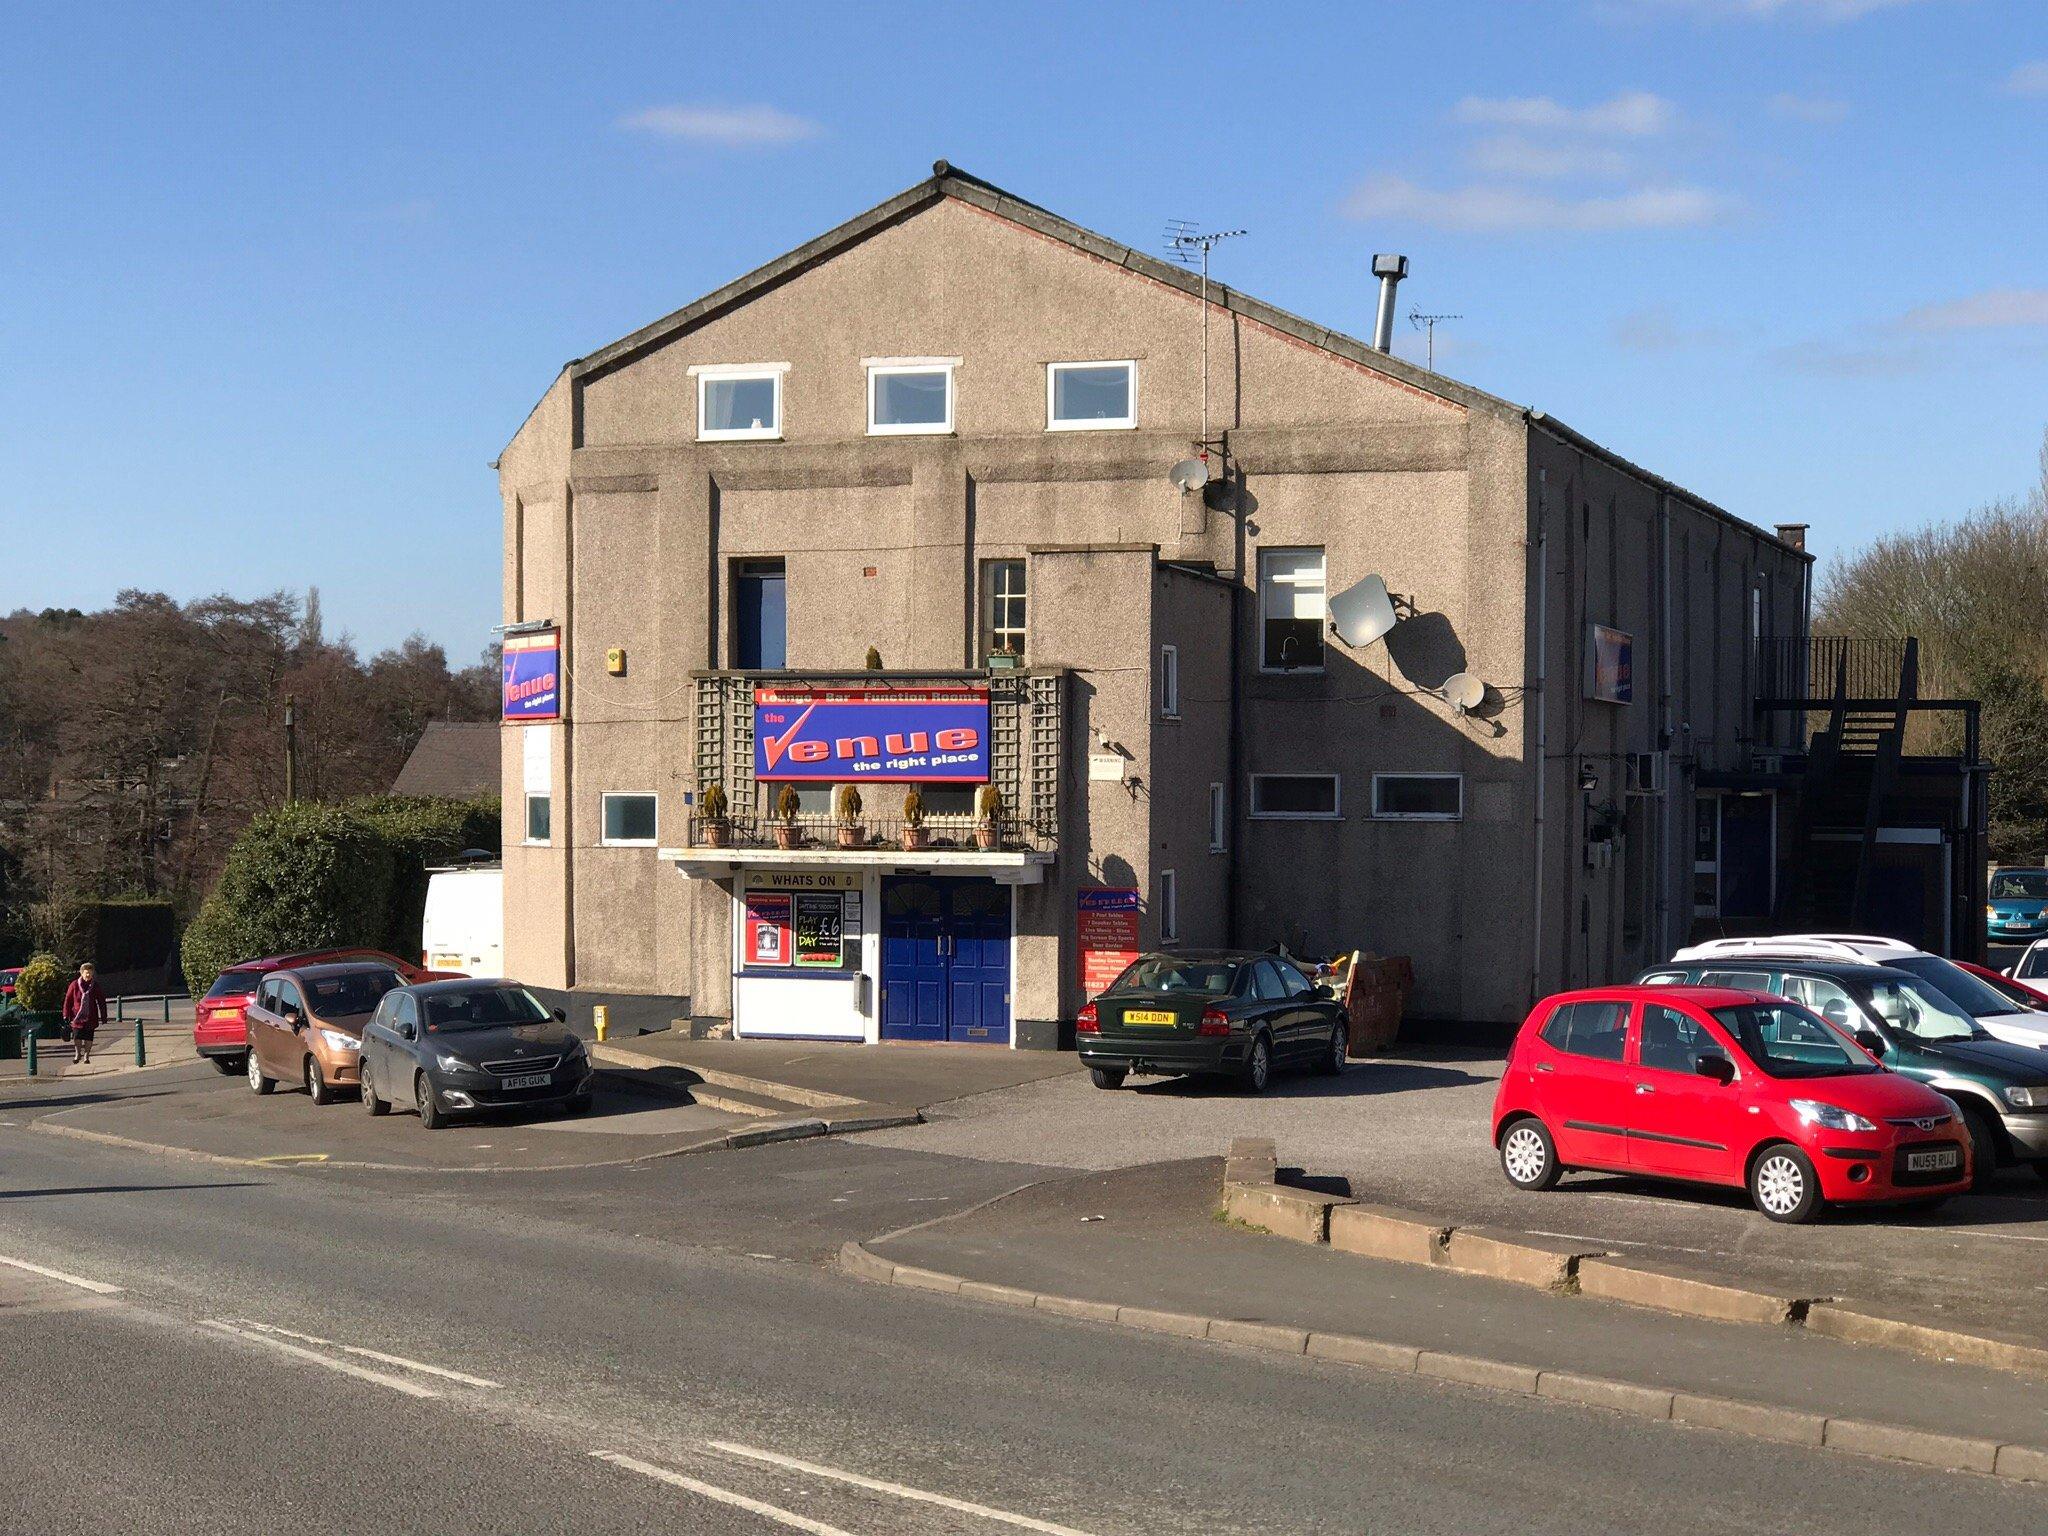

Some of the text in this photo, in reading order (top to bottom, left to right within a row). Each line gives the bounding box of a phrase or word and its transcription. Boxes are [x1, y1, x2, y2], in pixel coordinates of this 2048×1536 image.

[505, 648, 556, 708] Venue
[761, 692, 980, 705] Lounge Bar Function Rooms
[764, 712, 785, 723] the
[763, 700, 979, 773] Venue
[853, 752, 979, 772] the right place
[772, 875, 836, 886] WHATS ON
[799, 915, 818, 924] PLAY
[798, 936, 818, 947] DAY
[507, 1077, 527, 1088] AF15
[1912, 1152, 1954, 1168] NU59 RUJ
